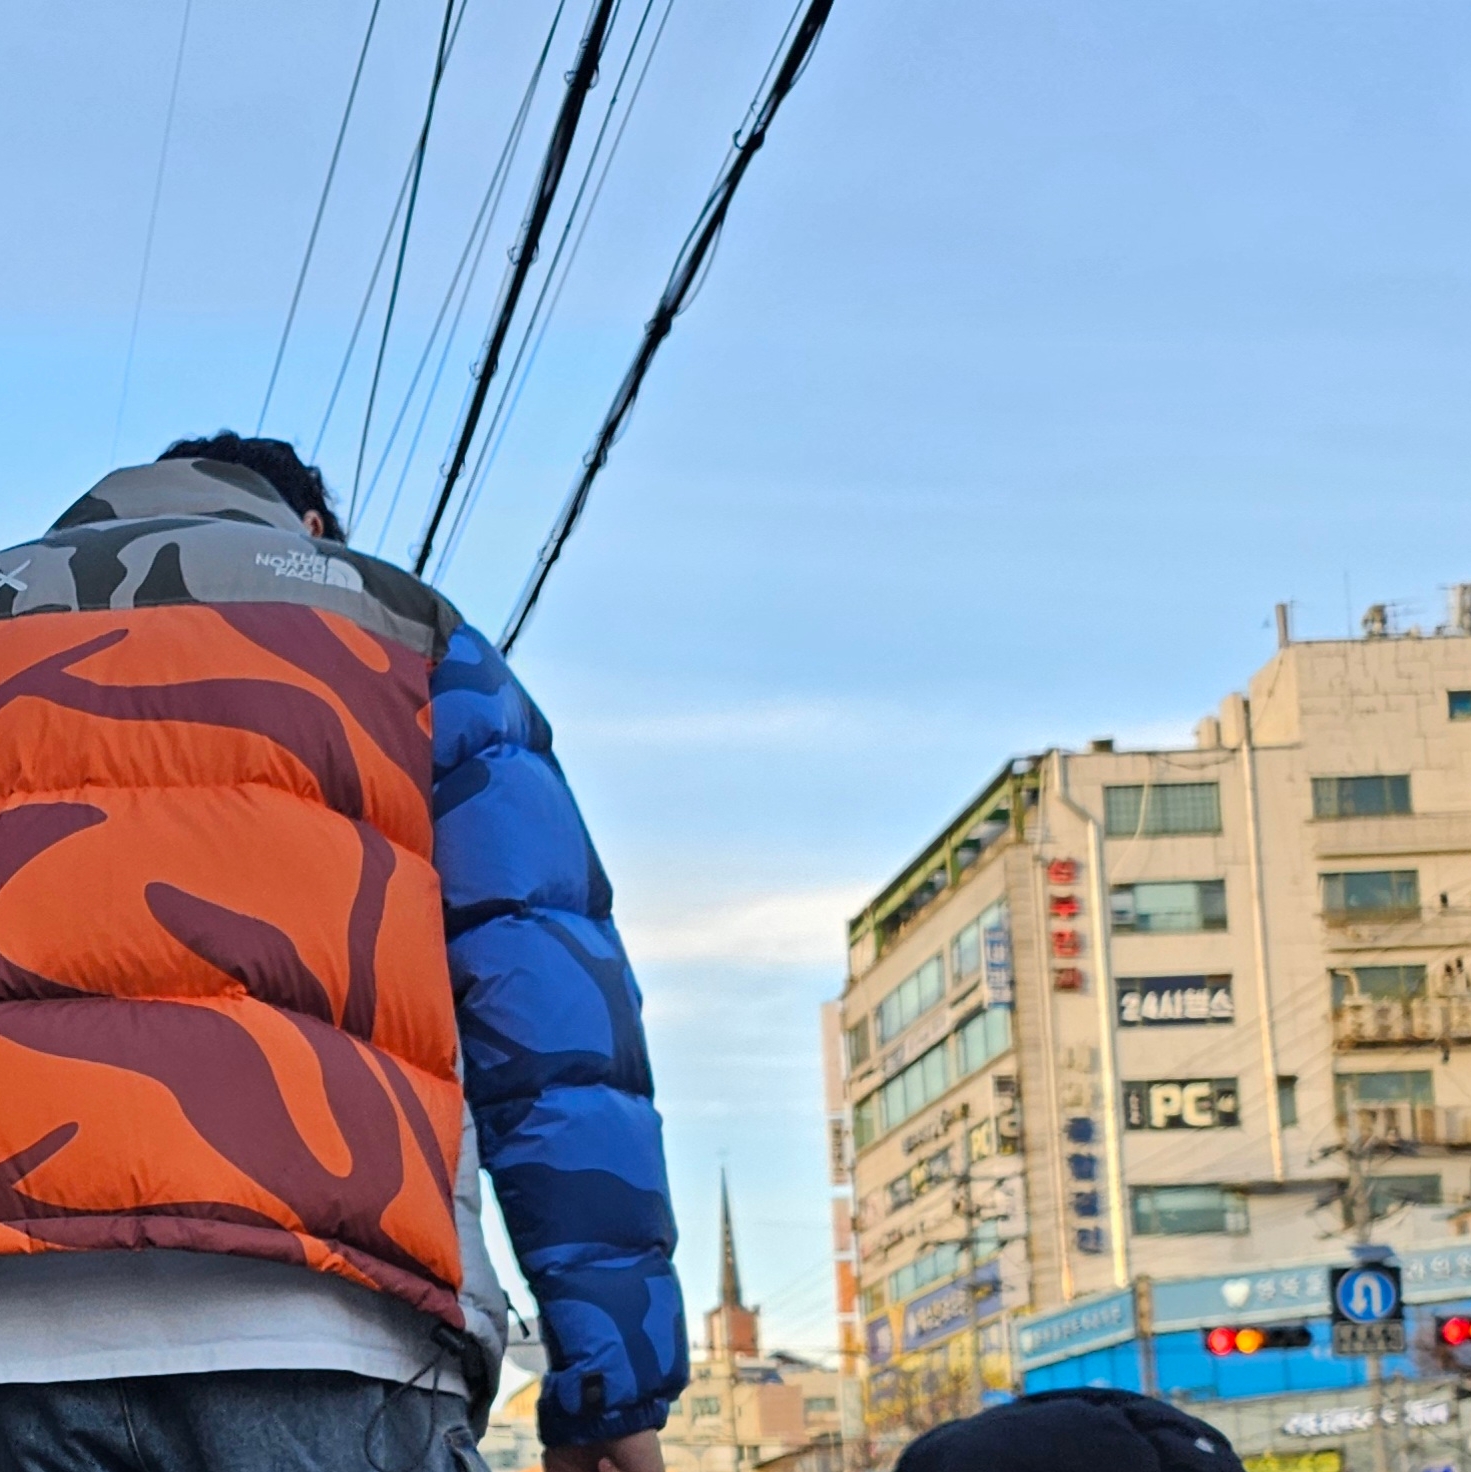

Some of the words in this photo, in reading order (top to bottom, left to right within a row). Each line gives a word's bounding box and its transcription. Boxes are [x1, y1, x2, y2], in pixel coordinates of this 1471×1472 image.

[255, 552, 326, 573] NORTH
[287, 549, 327, 563] THE
[275, 567, 327, 584] FACE
